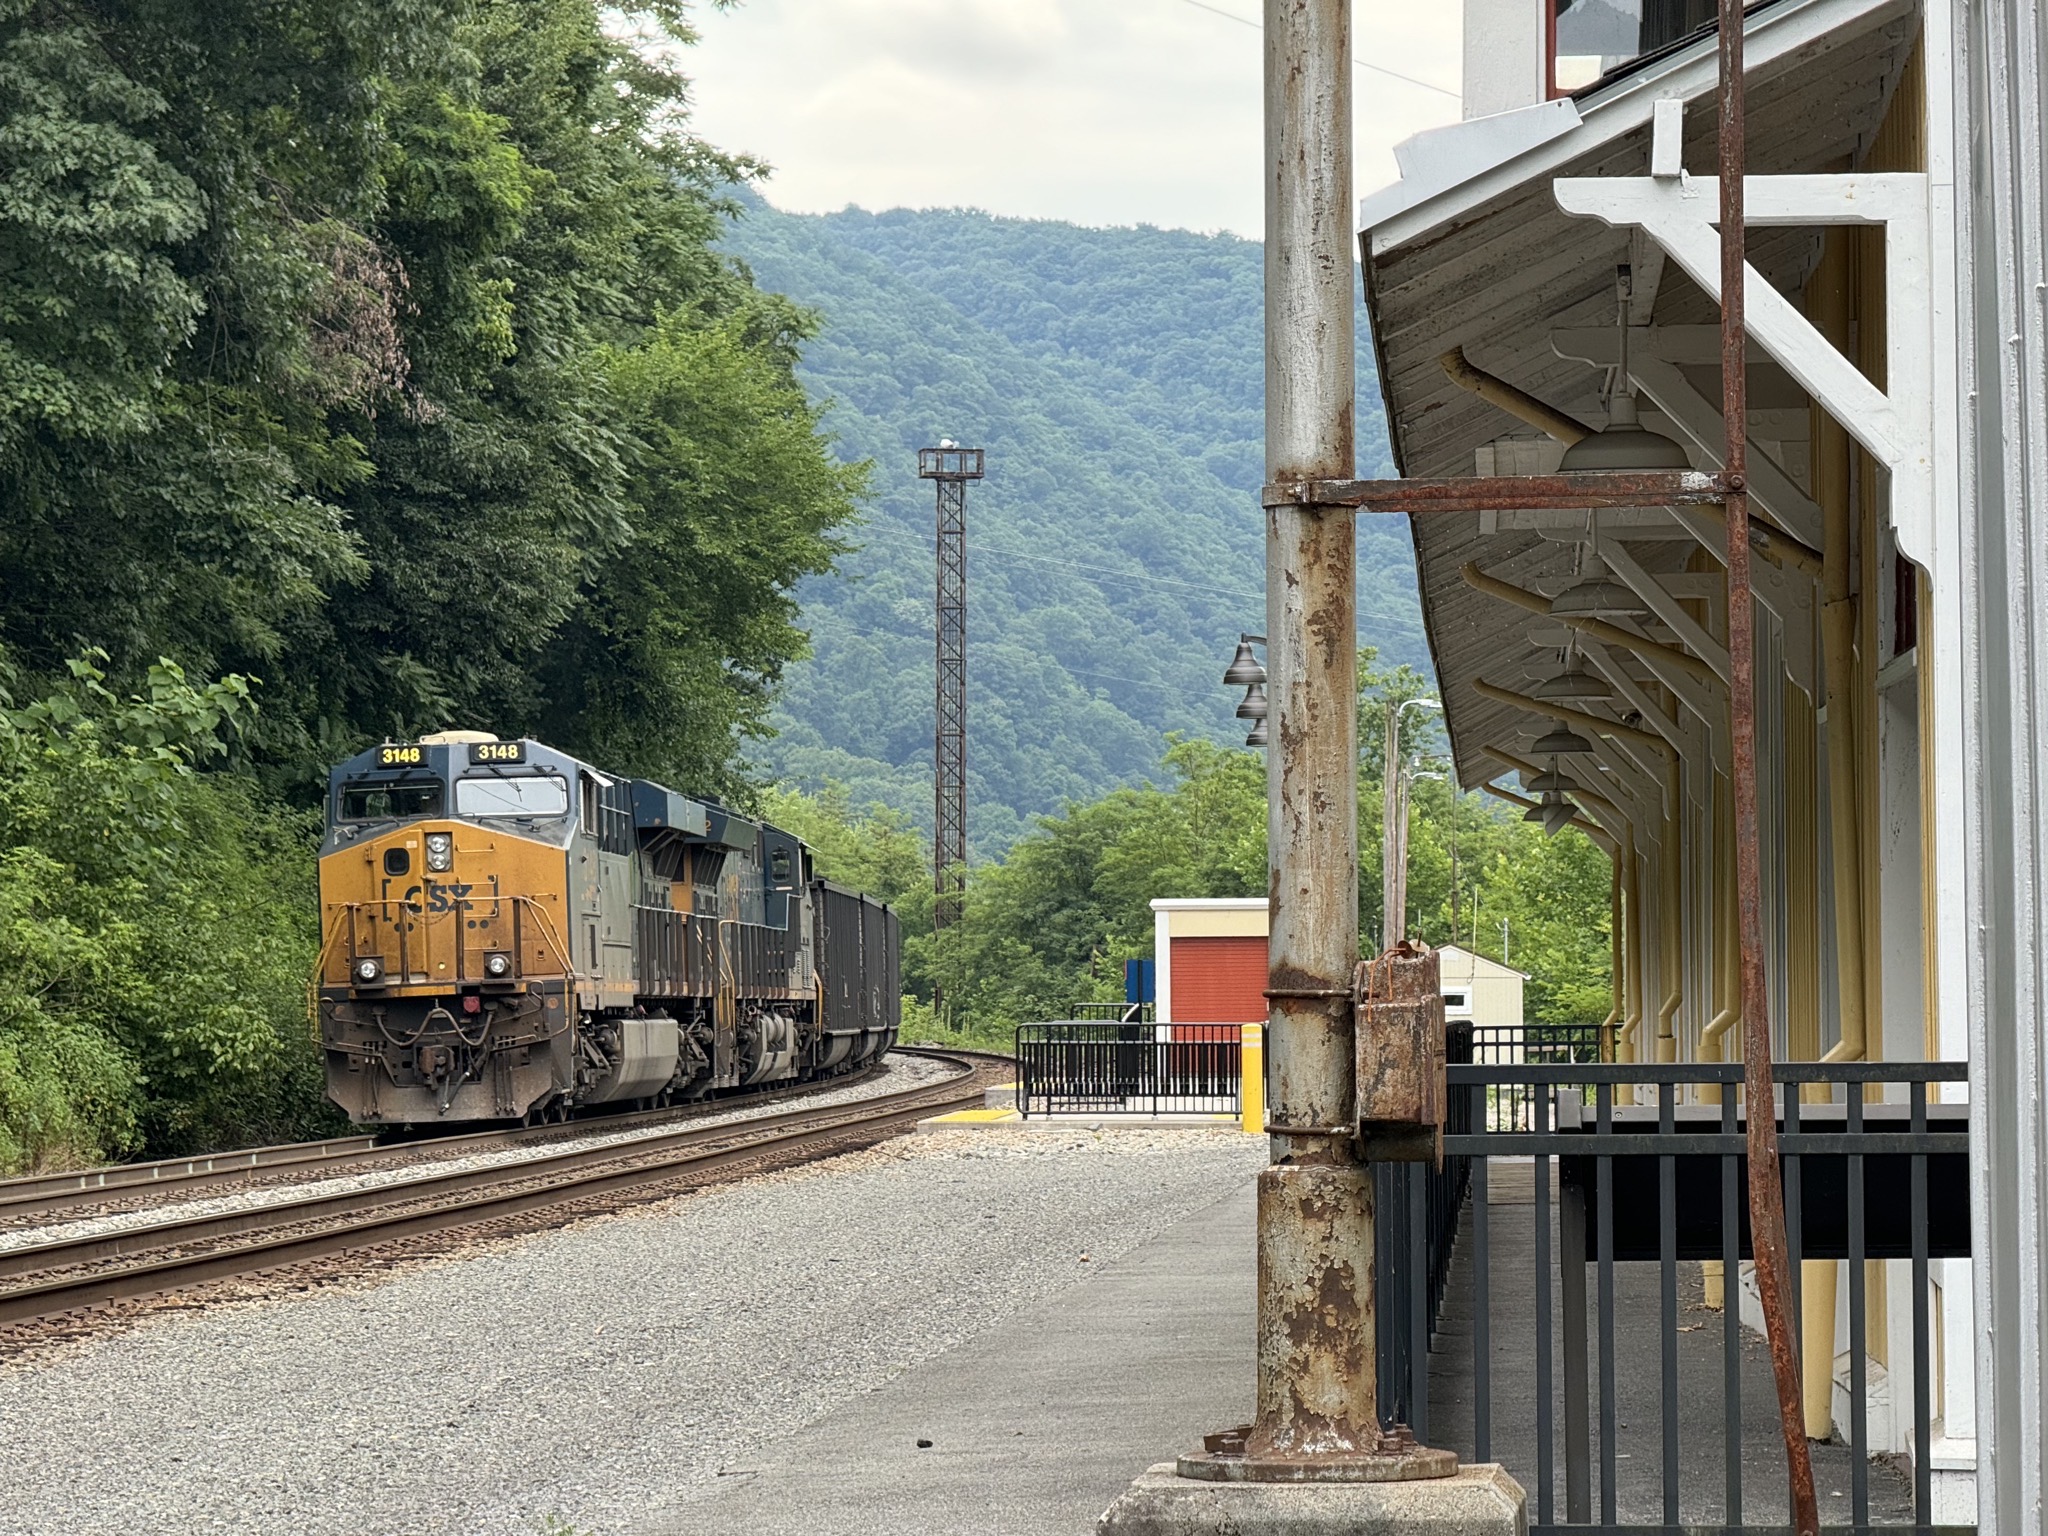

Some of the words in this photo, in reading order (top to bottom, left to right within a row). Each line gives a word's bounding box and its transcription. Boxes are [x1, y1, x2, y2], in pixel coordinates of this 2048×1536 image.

[382, 747, 421, 764] 3148
[478, 744, 518, 760] 3148
[405, 884, 474, 914] CSX
